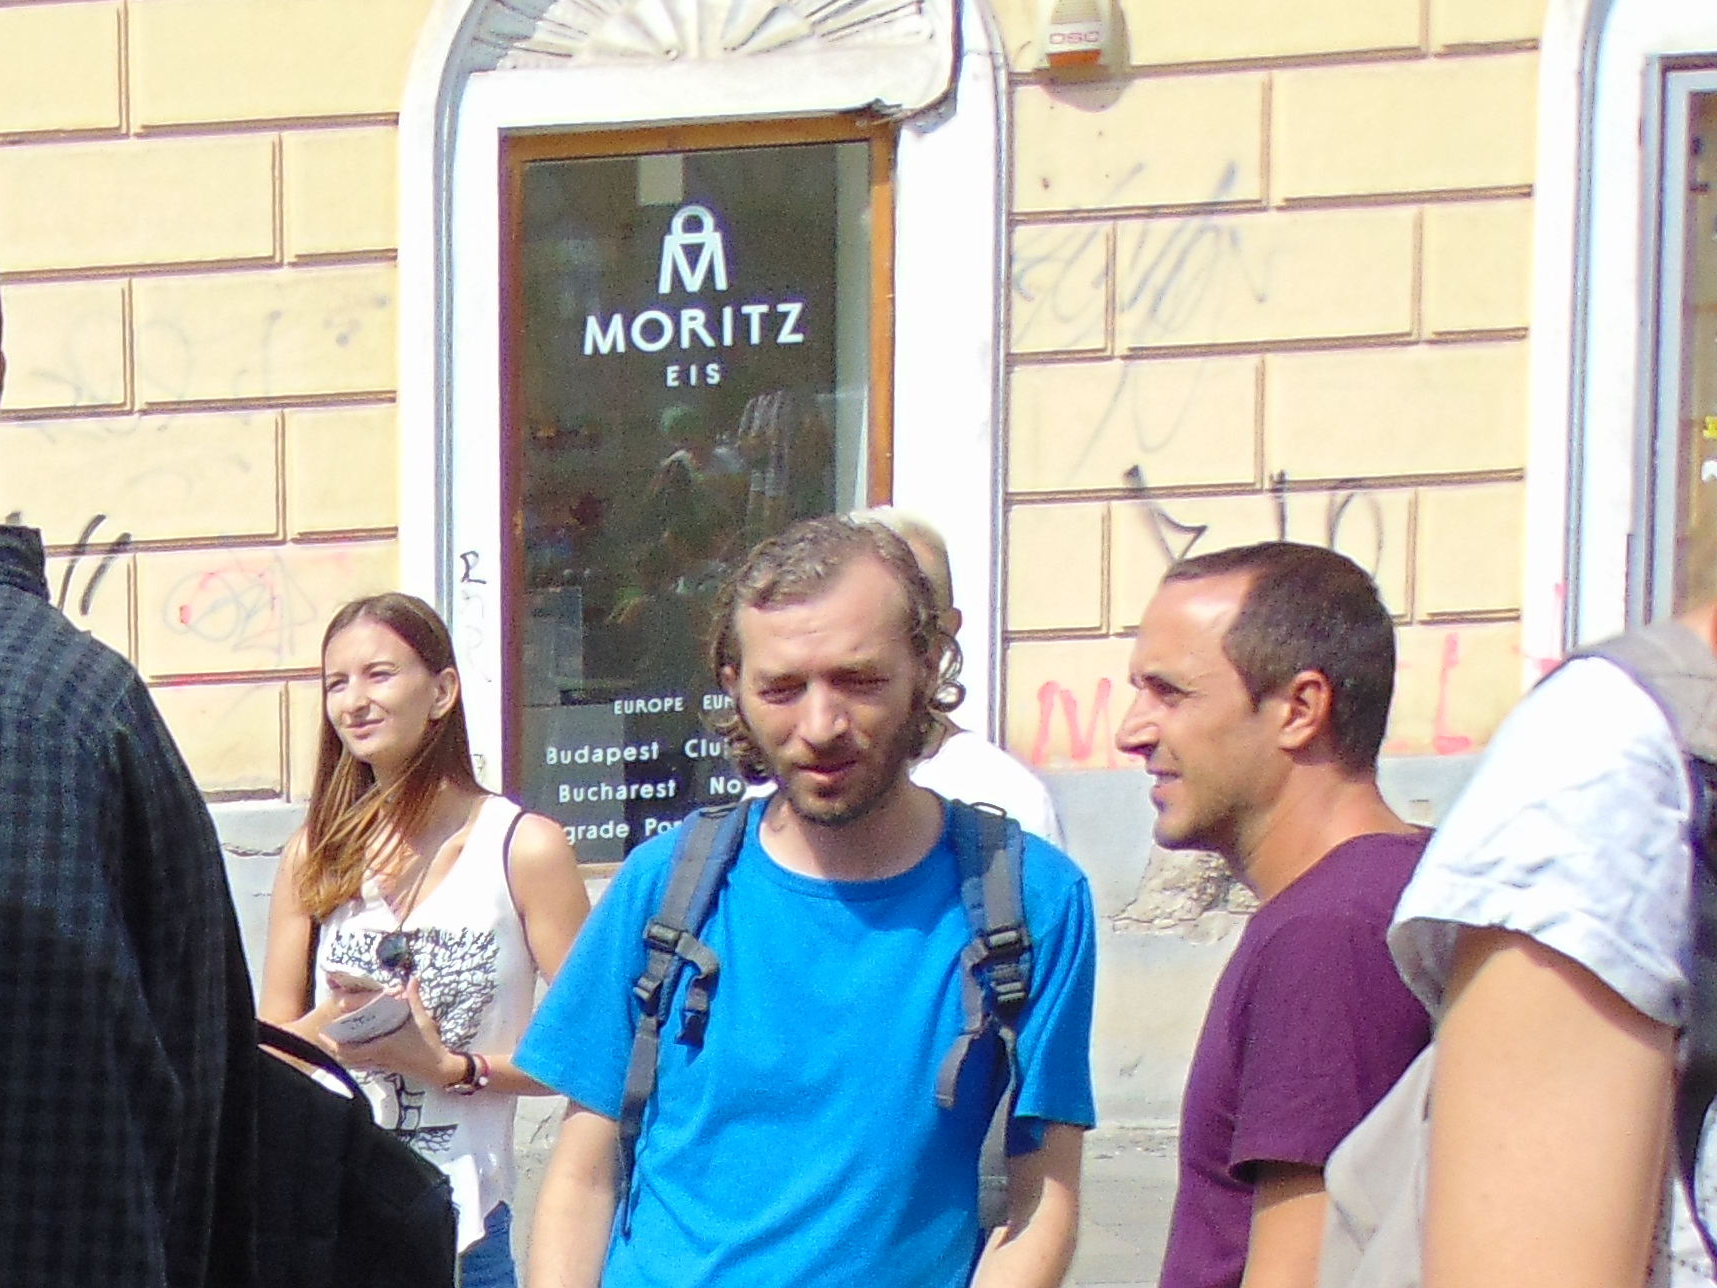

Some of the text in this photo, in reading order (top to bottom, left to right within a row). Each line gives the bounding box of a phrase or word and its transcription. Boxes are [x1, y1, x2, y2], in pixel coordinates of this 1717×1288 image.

[583, 302, 804, 355] MORITZ
[666, 363, 721, 387] EIS
[613, 697, 684, 715] EUROPE
[545, 741, 660, 766] Budapest
[558, 776, 742, 804] Bucharest No
[564, 820, 630, 845] grade
